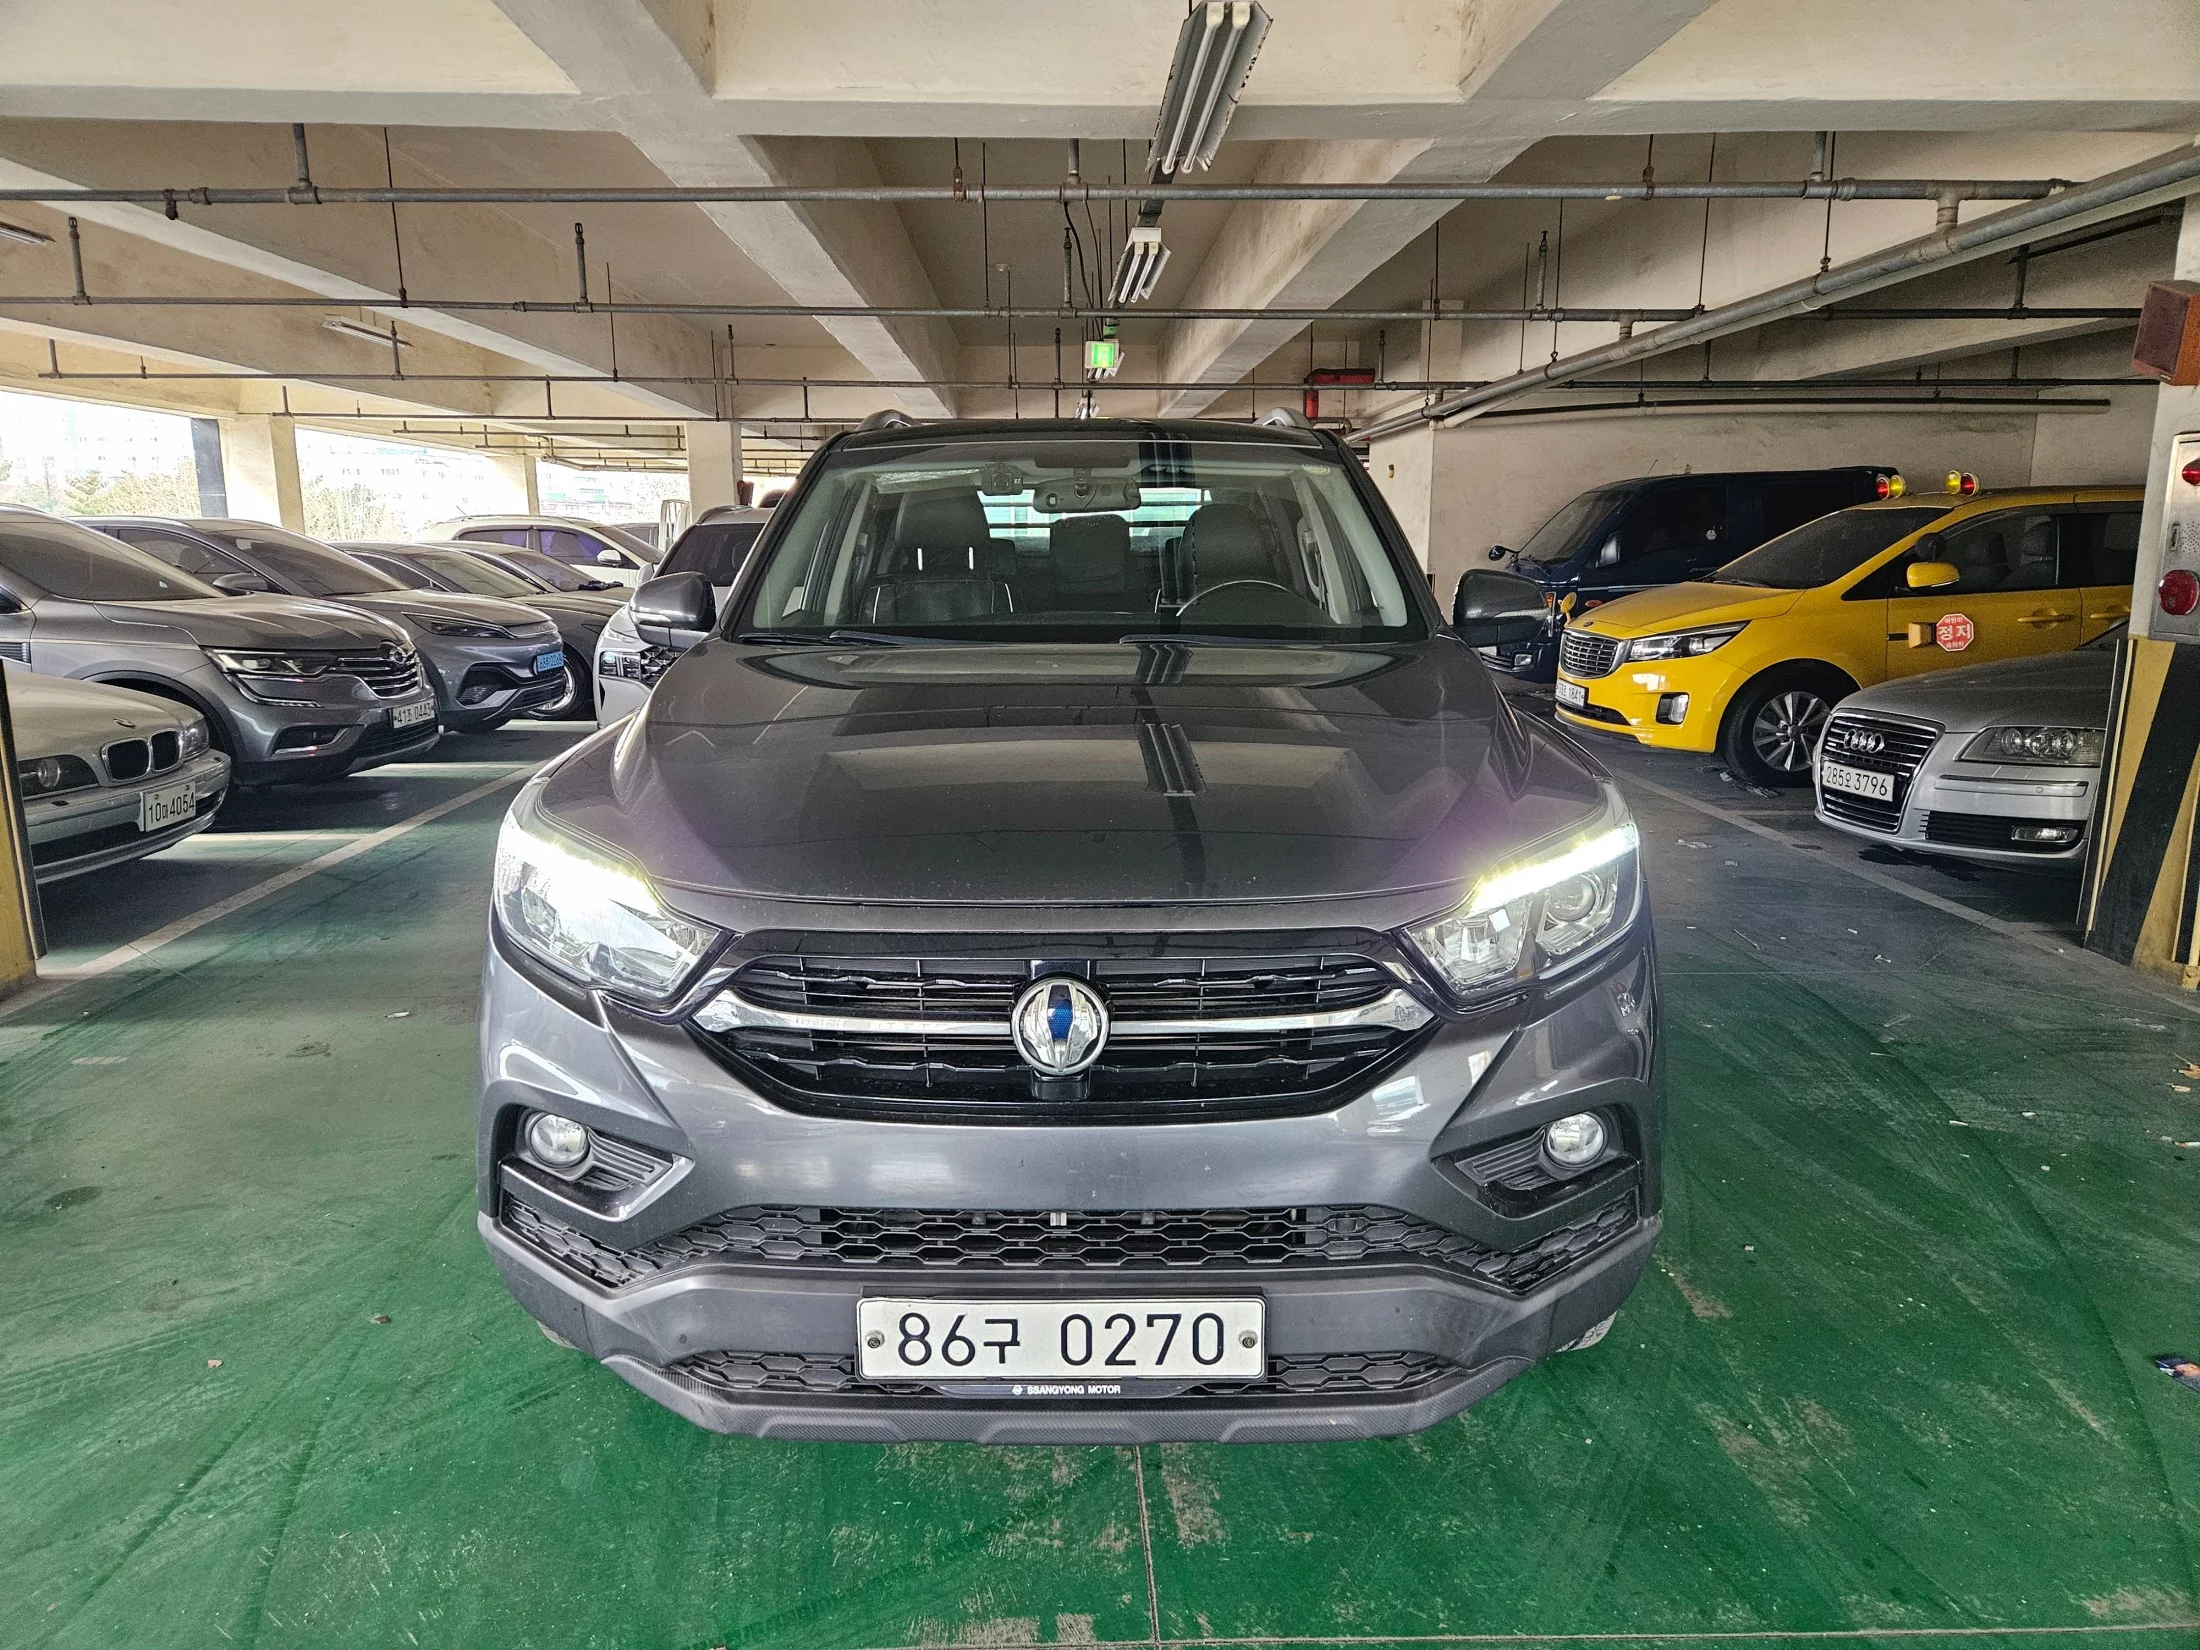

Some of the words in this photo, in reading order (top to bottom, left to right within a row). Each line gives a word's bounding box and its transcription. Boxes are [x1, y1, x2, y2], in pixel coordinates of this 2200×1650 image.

[897, 1312, 1021, 1366] 86구
[1060, 1312, 1225, 1366] 0270
[1026, 1384, 1085, 1395] SSANGYONG
[1087, 1384, 1121, 1395] MOTOR
